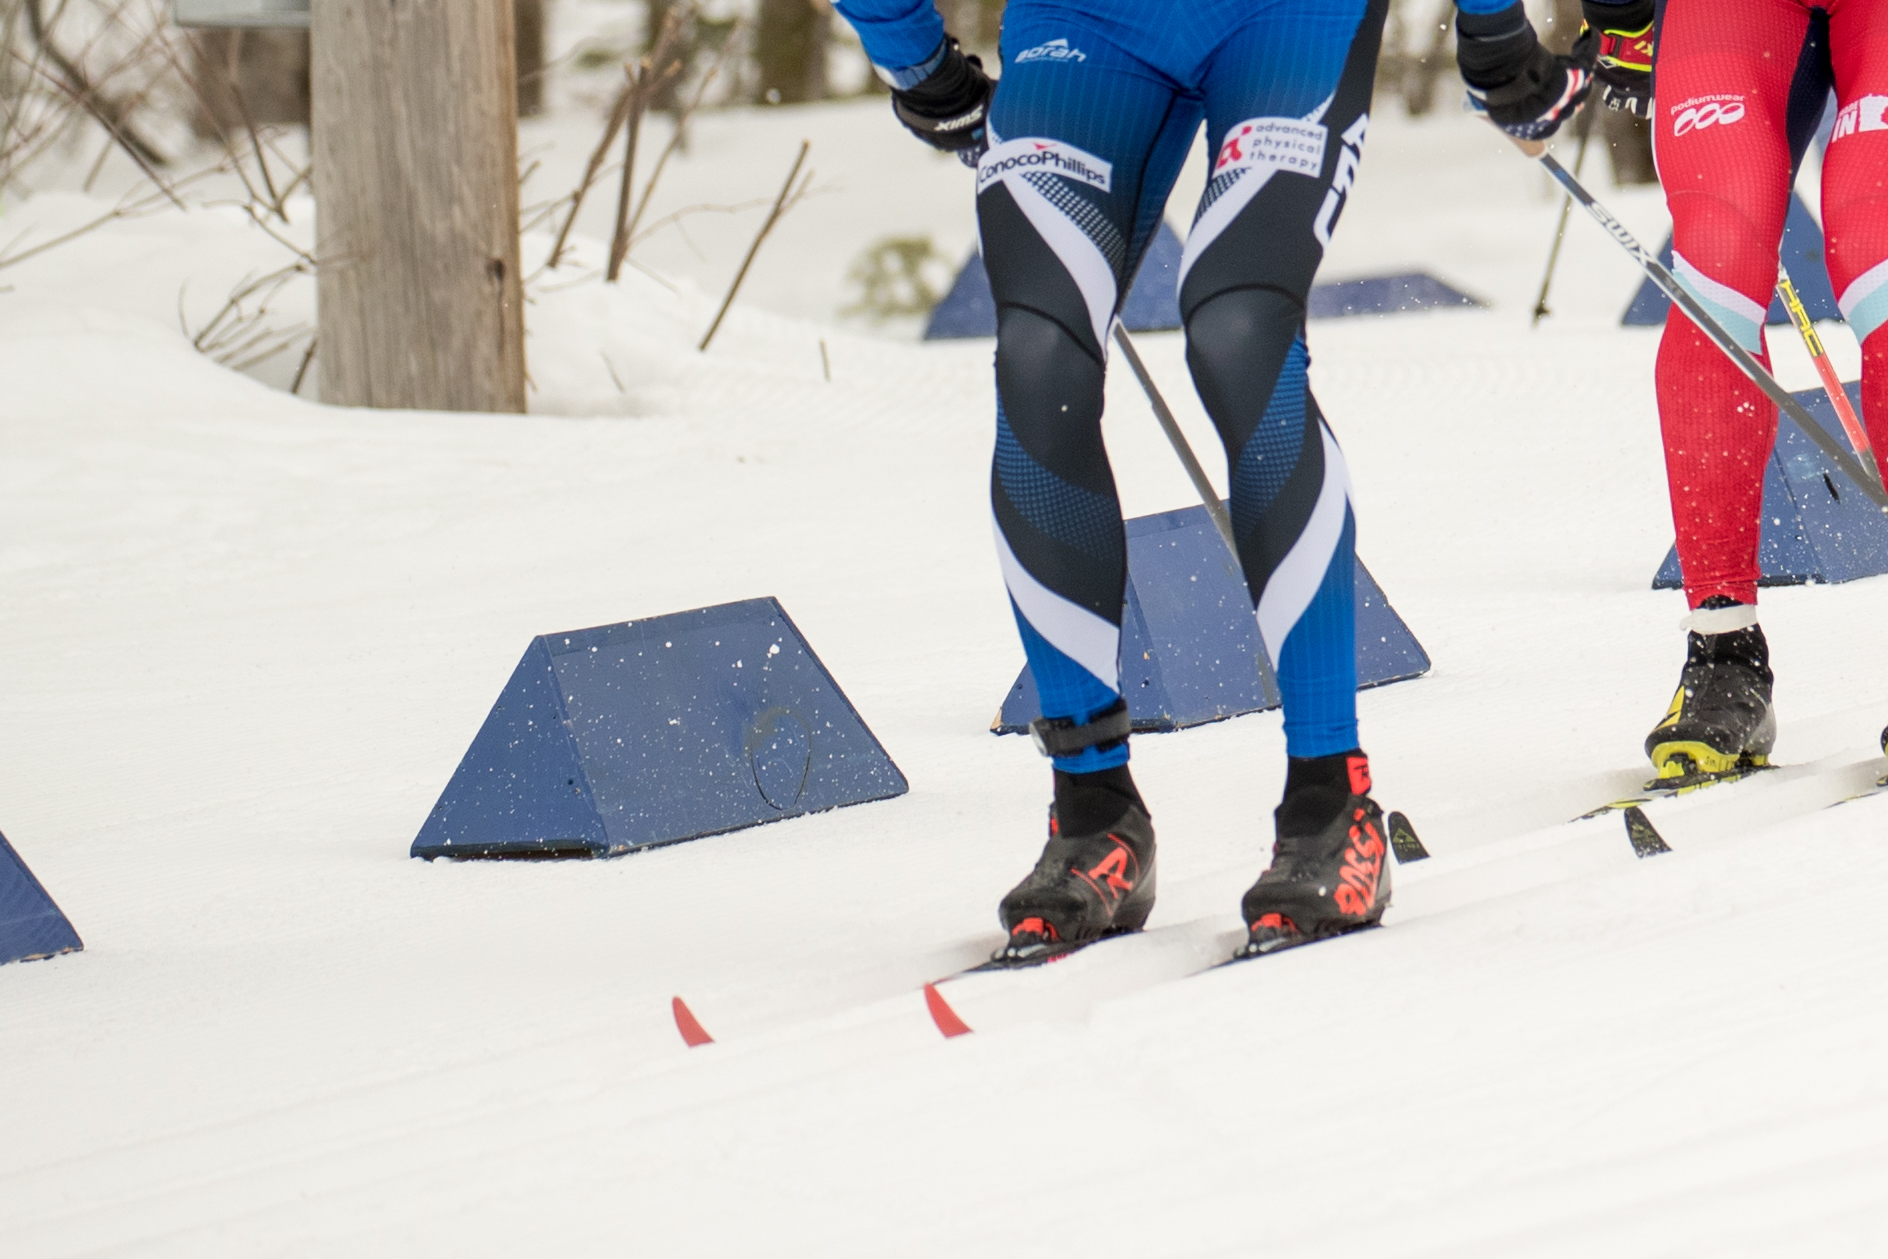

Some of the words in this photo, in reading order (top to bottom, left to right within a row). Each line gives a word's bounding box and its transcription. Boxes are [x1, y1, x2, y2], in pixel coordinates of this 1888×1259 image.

[1671, 94, 1745, 115] podiumwear
[1255, 122, 1323, 140] advanced
[1252, 136, 1321, 156] physical
[979, 151, 1106, 185] ConocoPhillips
[1250, 151, 1318, 170] therapy
